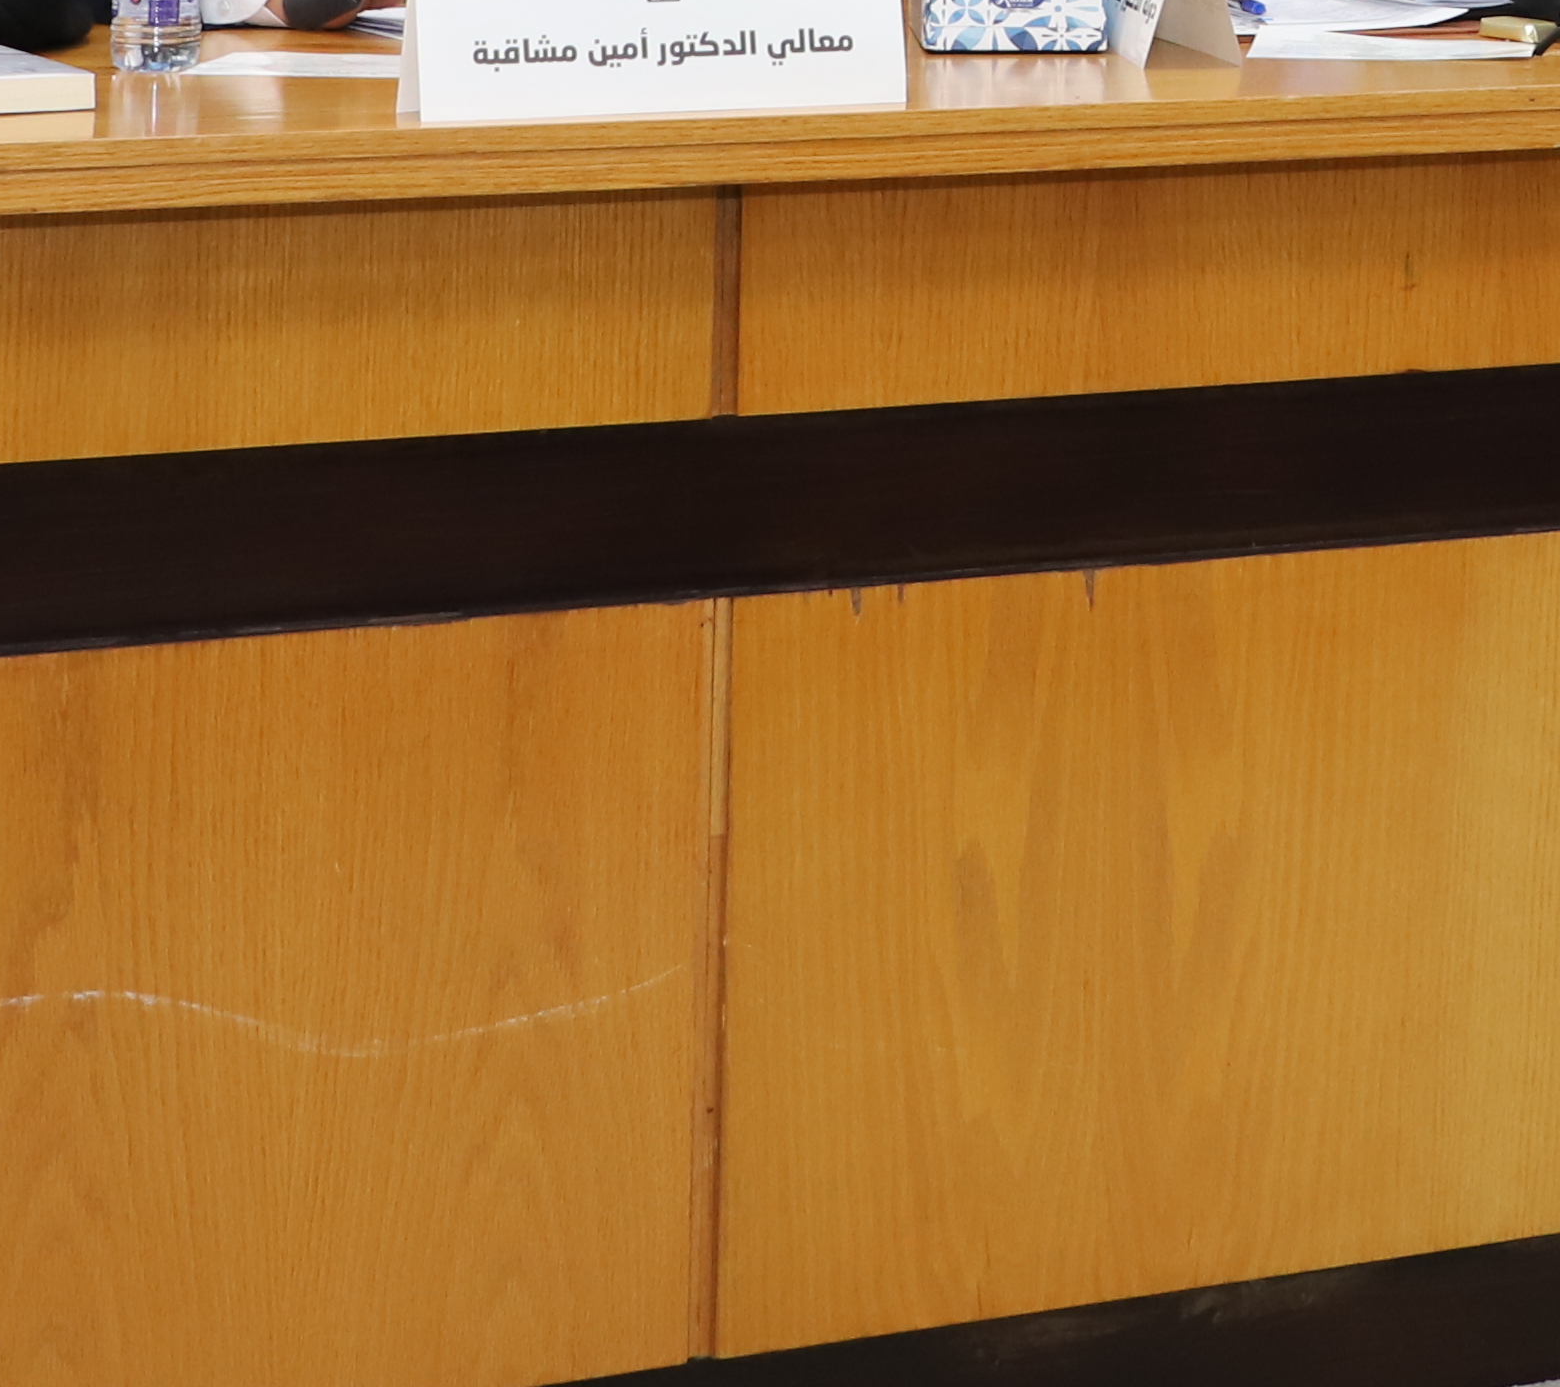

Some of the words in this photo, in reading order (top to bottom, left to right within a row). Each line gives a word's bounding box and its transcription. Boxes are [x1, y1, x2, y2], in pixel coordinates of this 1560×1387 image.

[471, 33, 579, 74] مشاقبة
[586, 26, 650, 69] أمين
[655, 28, 759, 68] الدكتور
[766, 27, 855, 67] معالي
